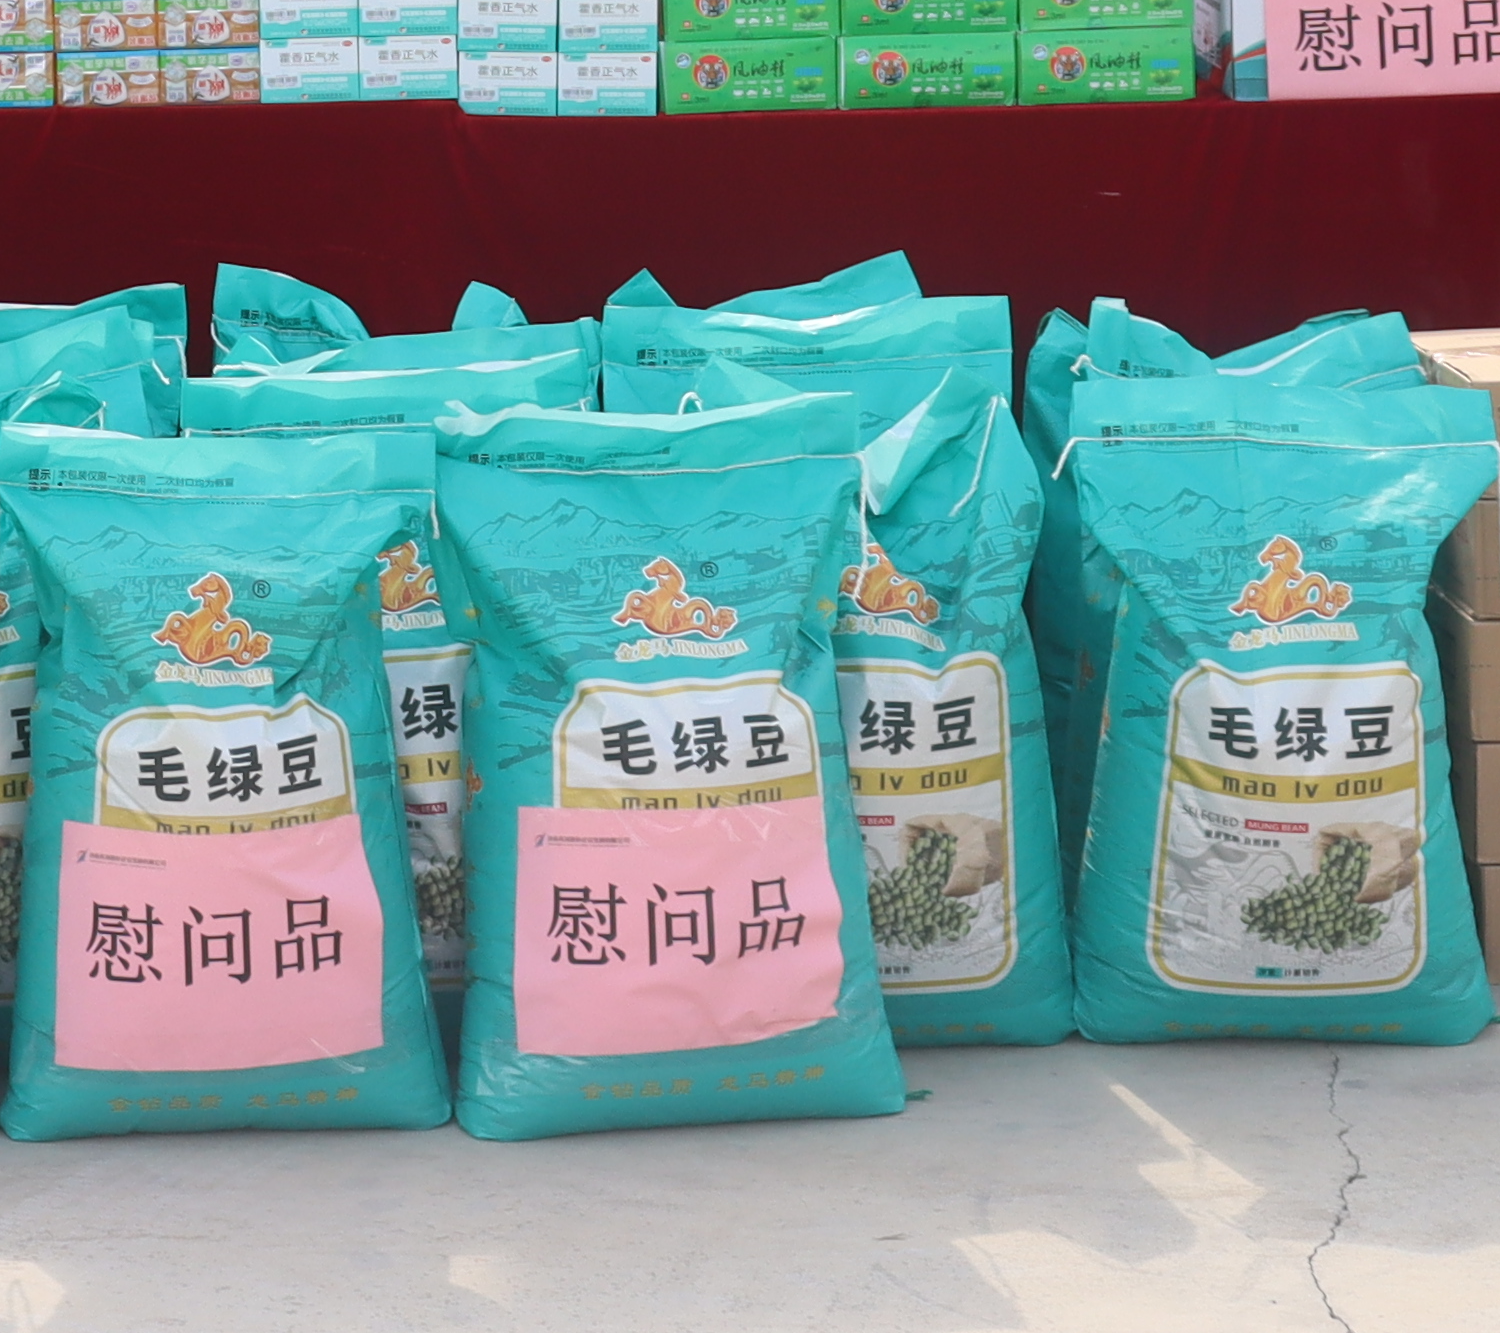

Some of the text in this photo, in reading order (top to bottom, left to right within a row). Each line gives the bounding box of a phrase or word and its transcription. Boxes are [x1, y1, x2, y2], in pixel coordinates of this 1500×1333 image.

[875, 617, 945, 650] JINLONGMA
[1281, 623, 1358, 642] JINLONGMA
[672, 639, 746, 657] JINLONGMA
[601, 714, 788, 775] 毛绿豆
[1209, 705, 1393, 760] 毛绿豆
[137, 735, 322, 803] 毛绿豆
[428, 757, 451, 776] lv
[880, 768, 967, 789] lv dou
[1222, 776, 1382, 798] mao lv dou
[1183, 805, 1238, 826] SELECTED
[548, 875, 806, 966] 慰问品
[86, 895, 344, 987] 慰问品
